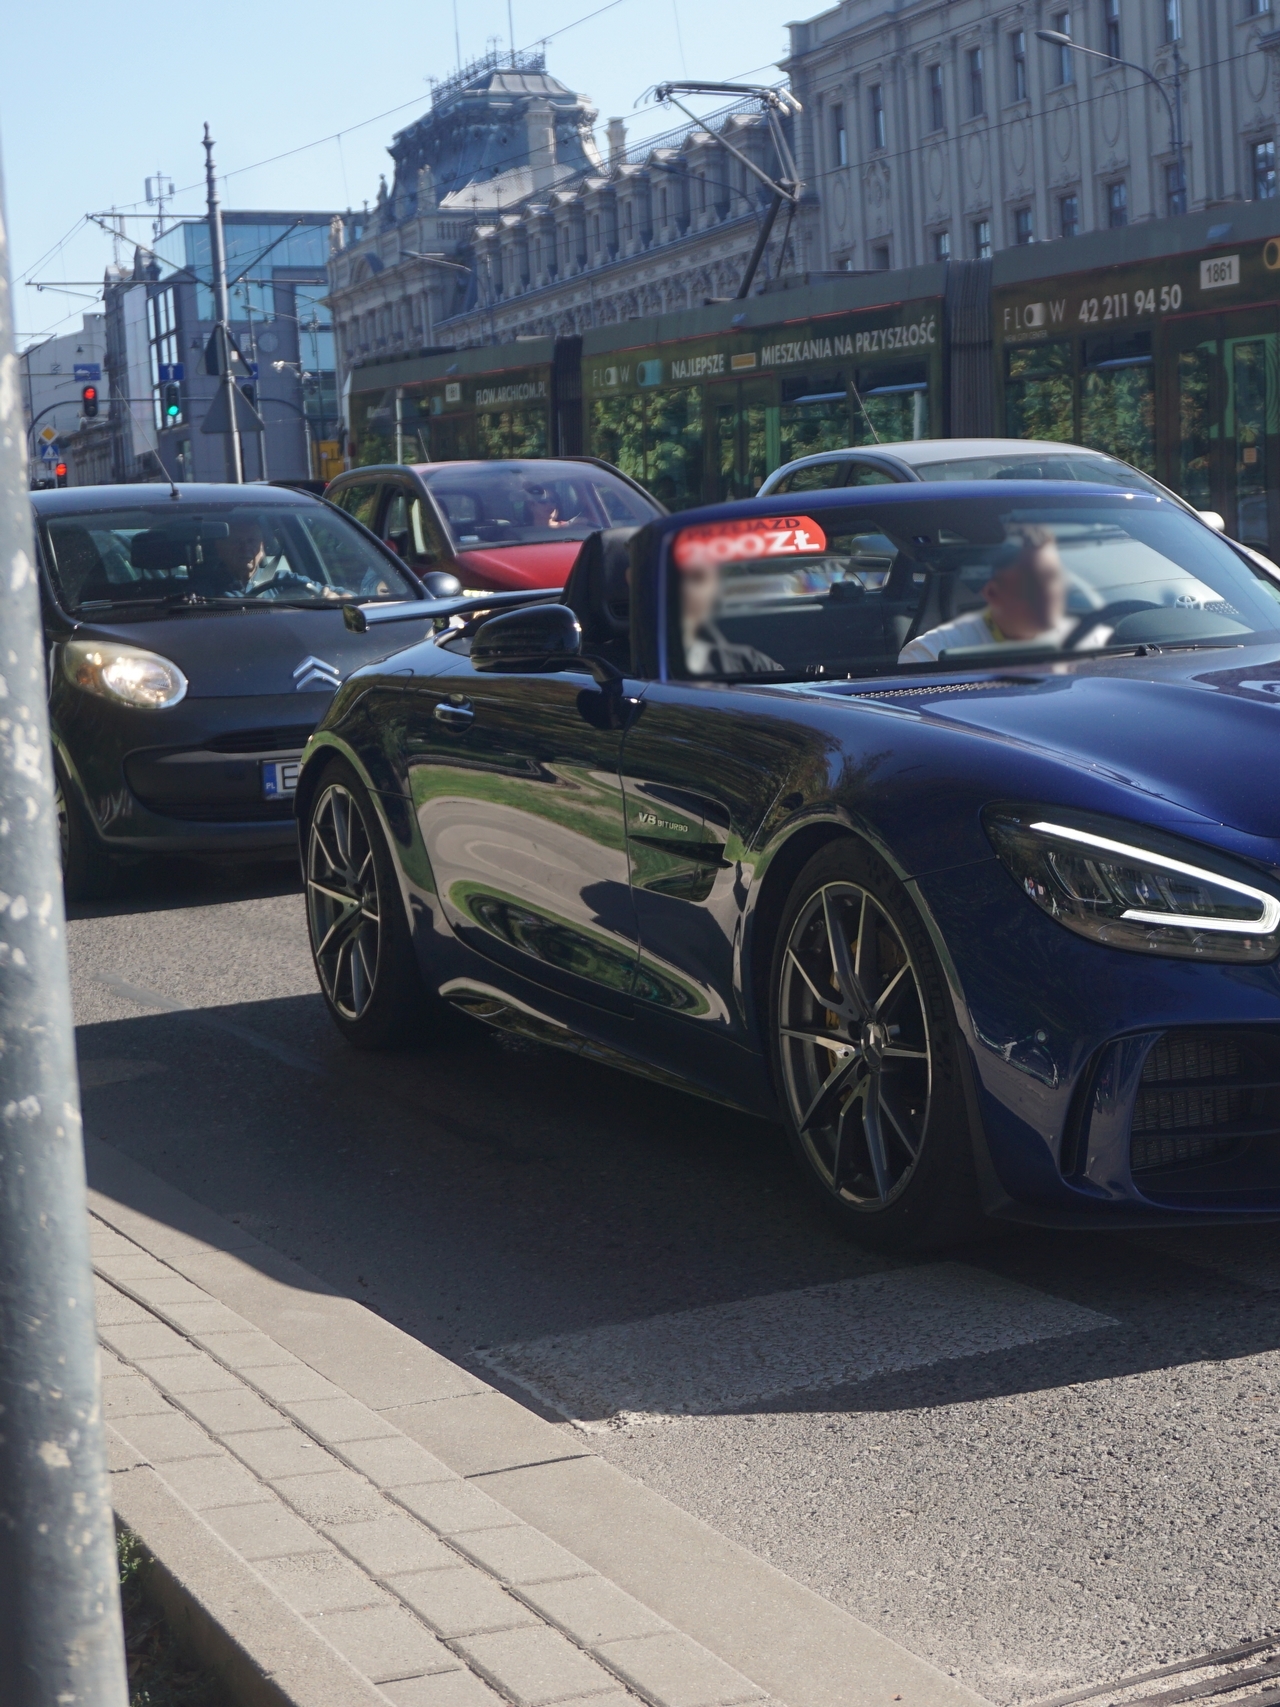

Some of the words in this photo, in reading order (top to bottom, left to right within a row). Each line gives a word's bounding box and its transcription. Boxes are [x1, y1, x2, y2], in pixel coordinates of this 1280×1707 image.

[1206, 261, 1233, 283] 1861
[1078, 298, 1098, 323] 42
[1103, 293, 1128, 320] 211
[1134, 289, 1155, 315] 94
[1160, 284, 1182, 312] 50
[671, 353, 724, 379] NAJLEPSZE
[761, 337, 832, 366] MIESZKANIA
[834, 334, 853, 356] NA
[855, 315, 936, 353] PRZYSZŁOŚĆ
[476, 381, 547, 406] FLOW.ARCHICOM.PL
[266, 782, 276, 790] PL
[638, 811, 657, 825] V8
[657, 819, 689, 833] BITURBO
